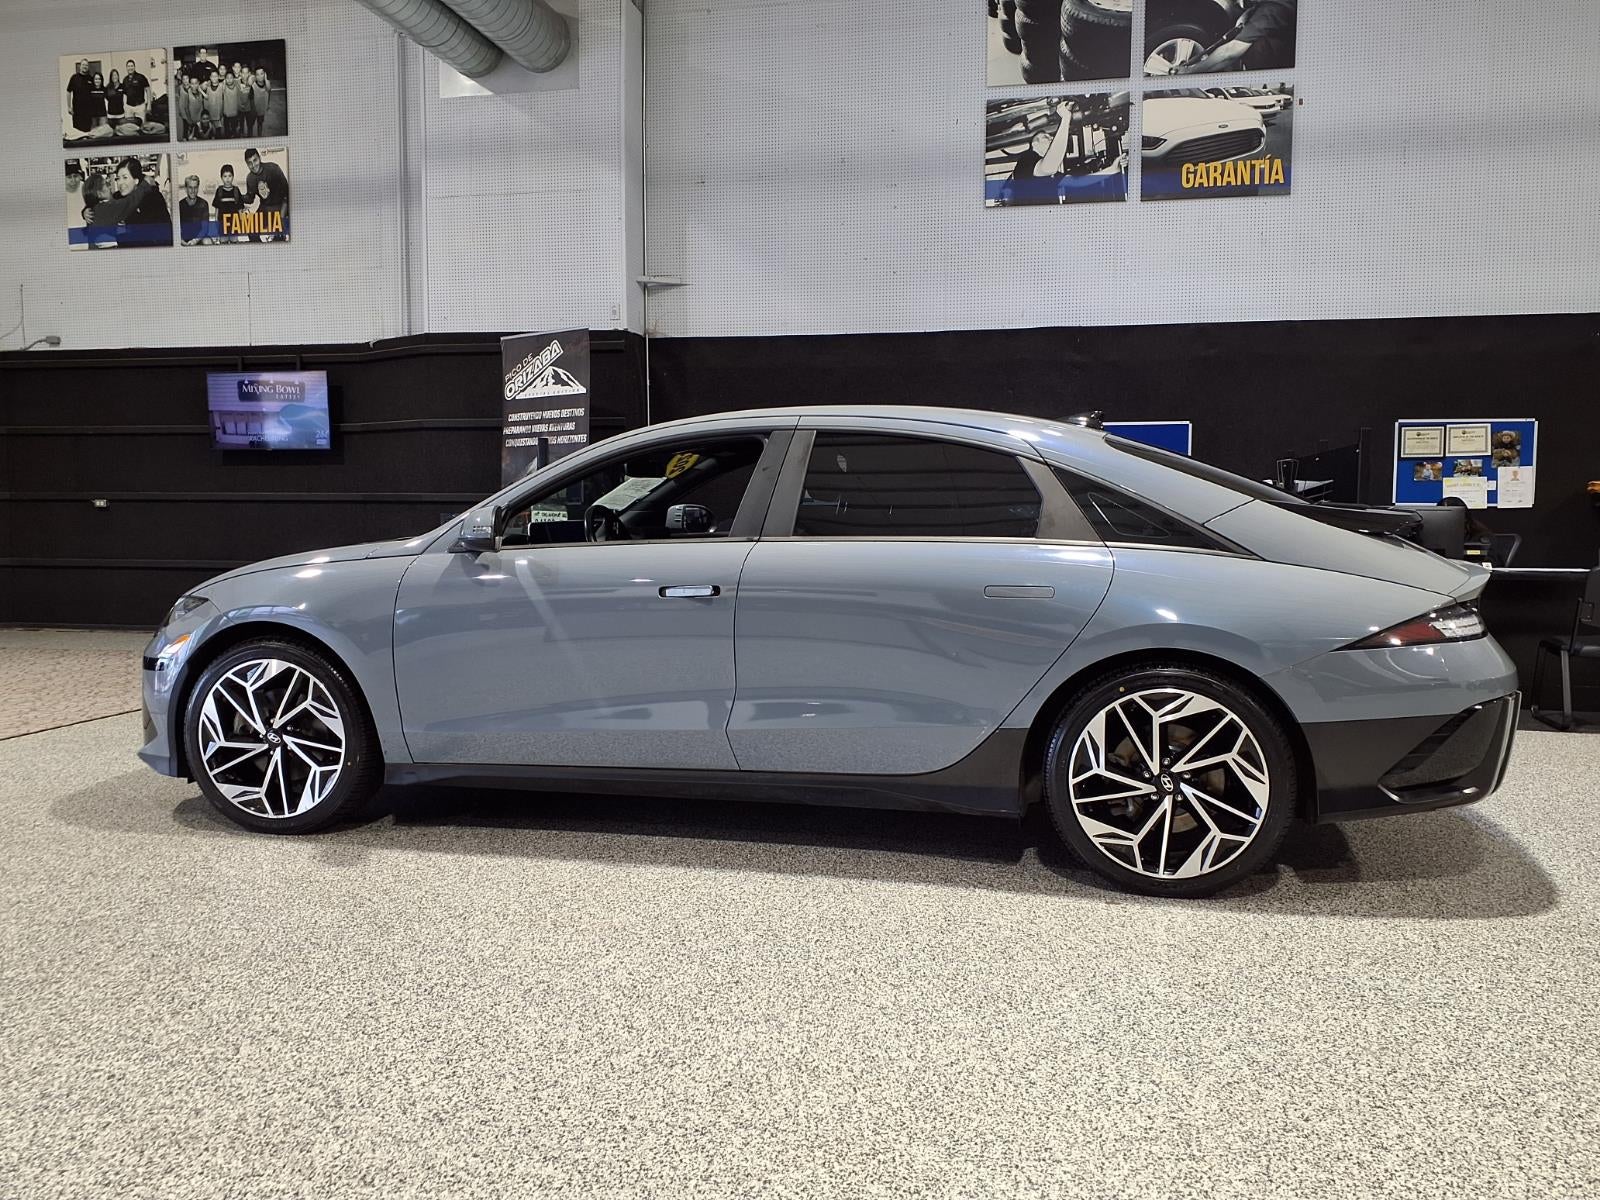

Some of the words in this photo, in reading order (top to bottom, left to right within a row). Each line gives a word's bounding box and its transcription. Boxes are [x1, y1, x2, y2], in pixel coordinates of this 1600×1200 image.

[1181, 154, 1285, 188] GARANTÍA
[222, 211, 283, 235] FAMILIA
[505, 364, 522, 382] PICO
[522, 352, 533, 366] DE
[506, 341, 561, 399] ORIZABA
[560, 408, 585, 418] DESTINOS
[557, 434, 587, 444] HORIZONTES
